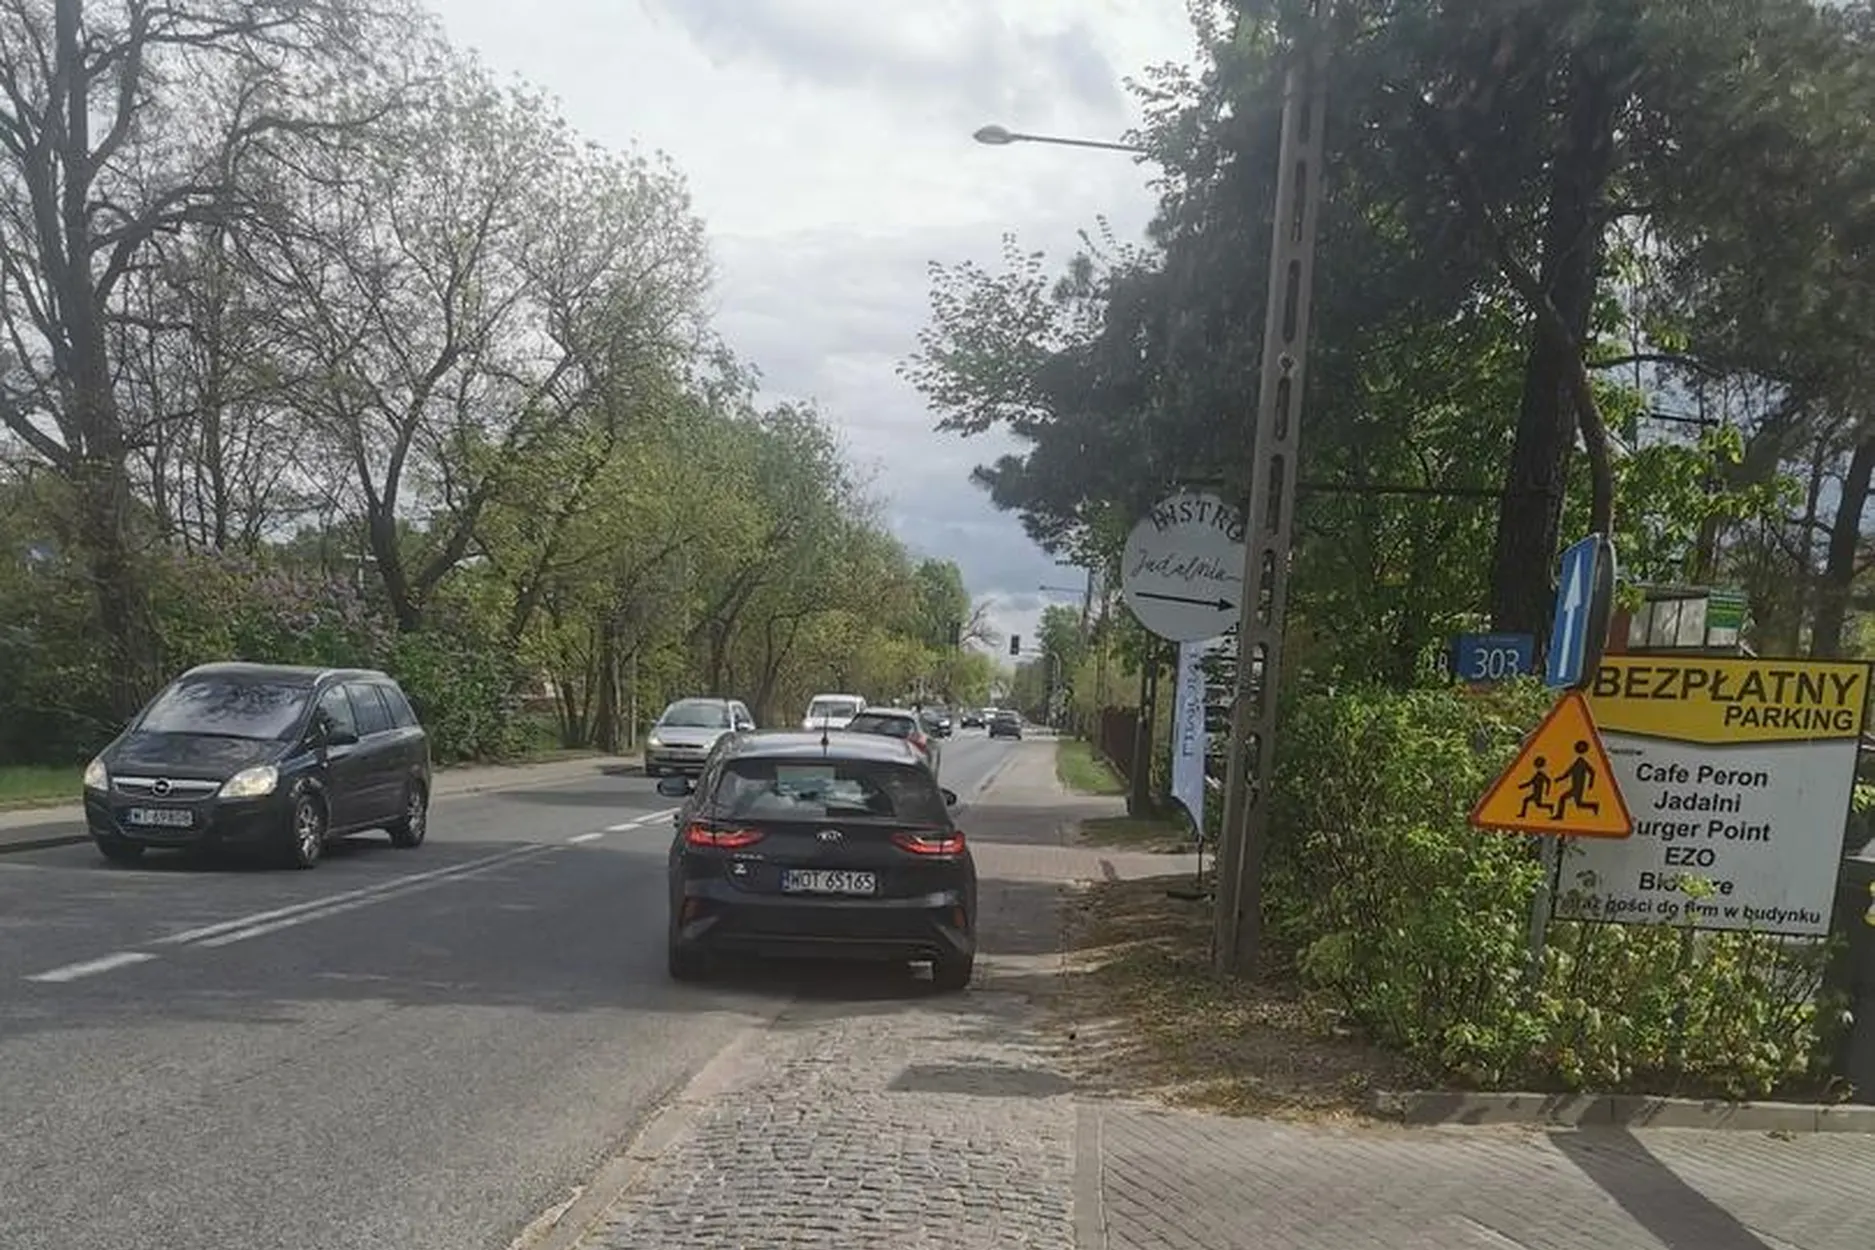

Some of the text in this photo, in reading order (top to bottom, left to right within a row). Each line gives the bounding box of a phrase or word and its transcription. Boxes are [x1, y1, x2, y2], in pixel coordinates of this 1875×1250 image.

[1471, 648, 1520, 679] 303
[1593, 666, 1860, 706] BEZPŁATNY
[1724, 705, 1854, 731] PARKING
[1636, 763, 1769, 788] Cafe Peron
[1654, 791, 1742, 813] Jadalni
[1631, 820, 1771, 842] urger Point
[1664, 846, 1716, 868] EZO
[1639, 871, 1735, 896] Biore
[1657, 898, 1680, 917] do
[1724, 906, 1741, 920] w
[1743, 906, 1821, 925] budynku
